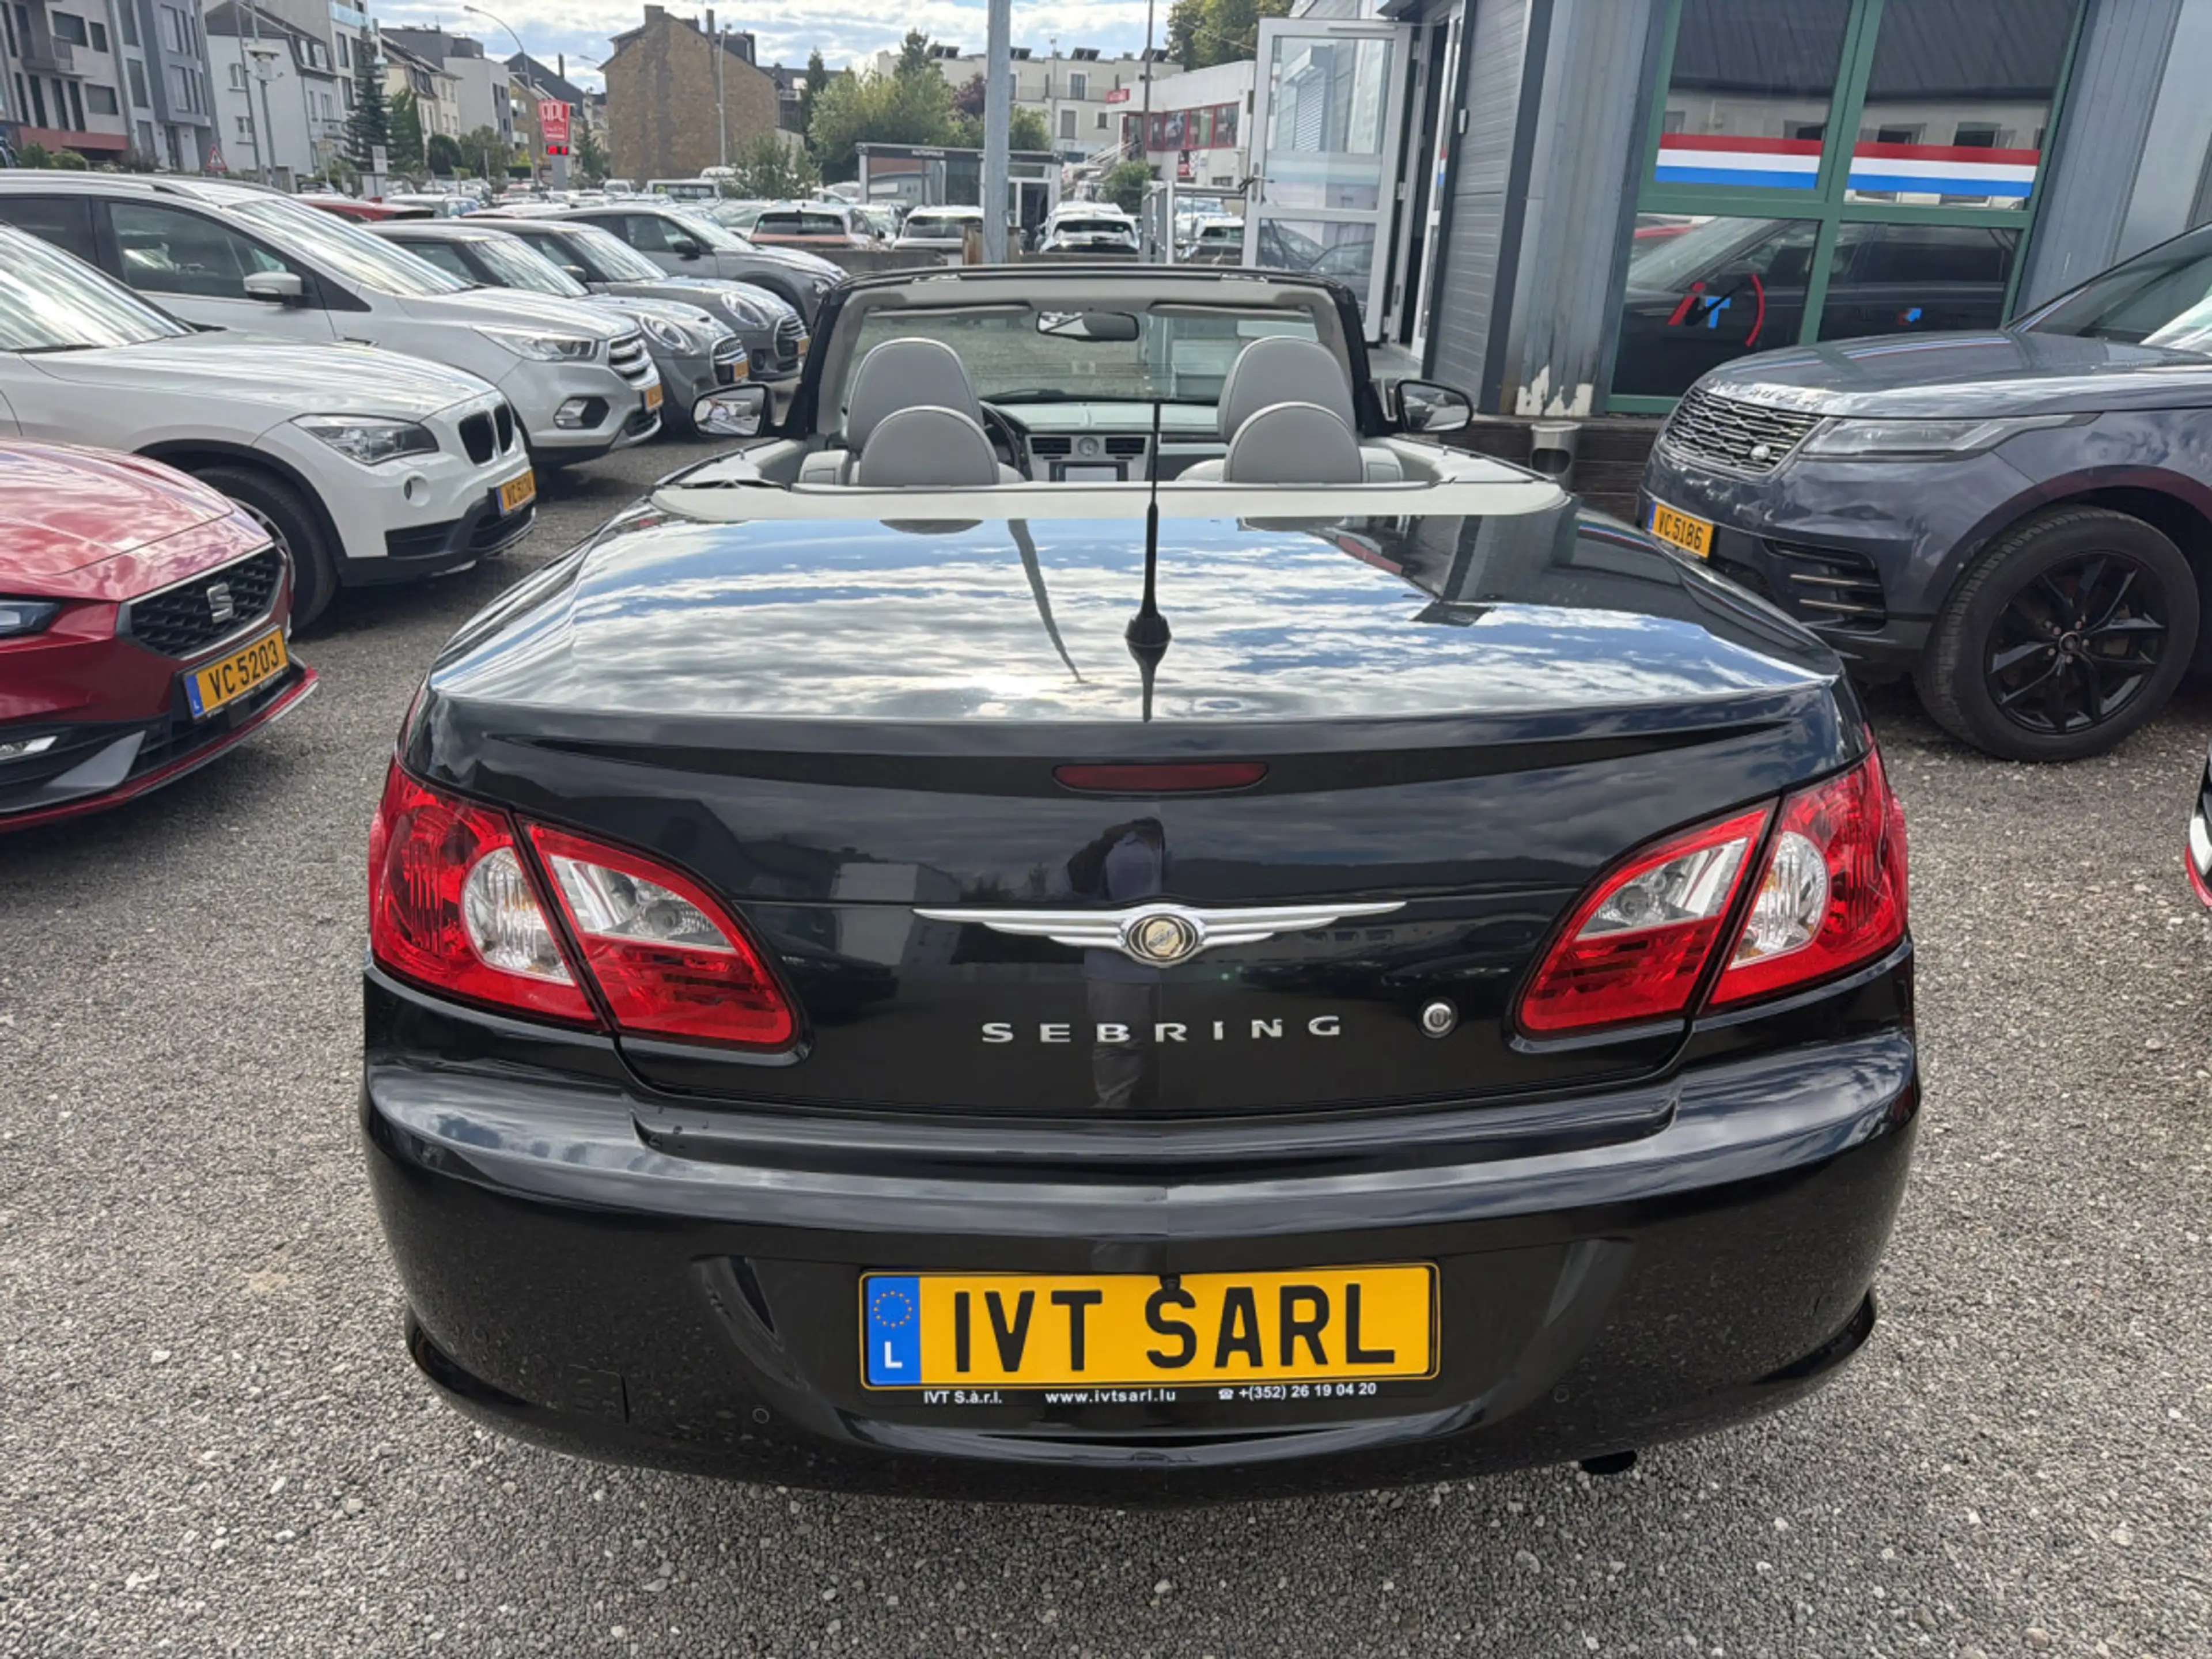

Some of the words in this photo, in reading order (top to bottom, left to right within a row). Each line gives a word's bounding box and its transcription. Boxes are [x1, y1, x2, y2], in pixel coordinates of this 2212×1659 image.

[209, 664, 236, 700] VC
[236, 639, 279, 685] 5203
[982, 1015, 1340, 1043] SEBRING
[954, 1290, 1103, 1373] IVT
[1145, 1283, 1396, 1369] SARL
[884, 1340, 903, 1369] L
[923, 1391, 950, 1404] IVT
[1045, 1388, 1176, 1404] www.ivtsarl.lu
[1238, 1385, 1286, 1401] +(352)
[1290, 1384, 1309, 1398] 26
[1314, 1384, 1332, 1397] 19
[1335, 1382, 1354, 1396] 04
[1358, 1381, 1377, 1395] 20
